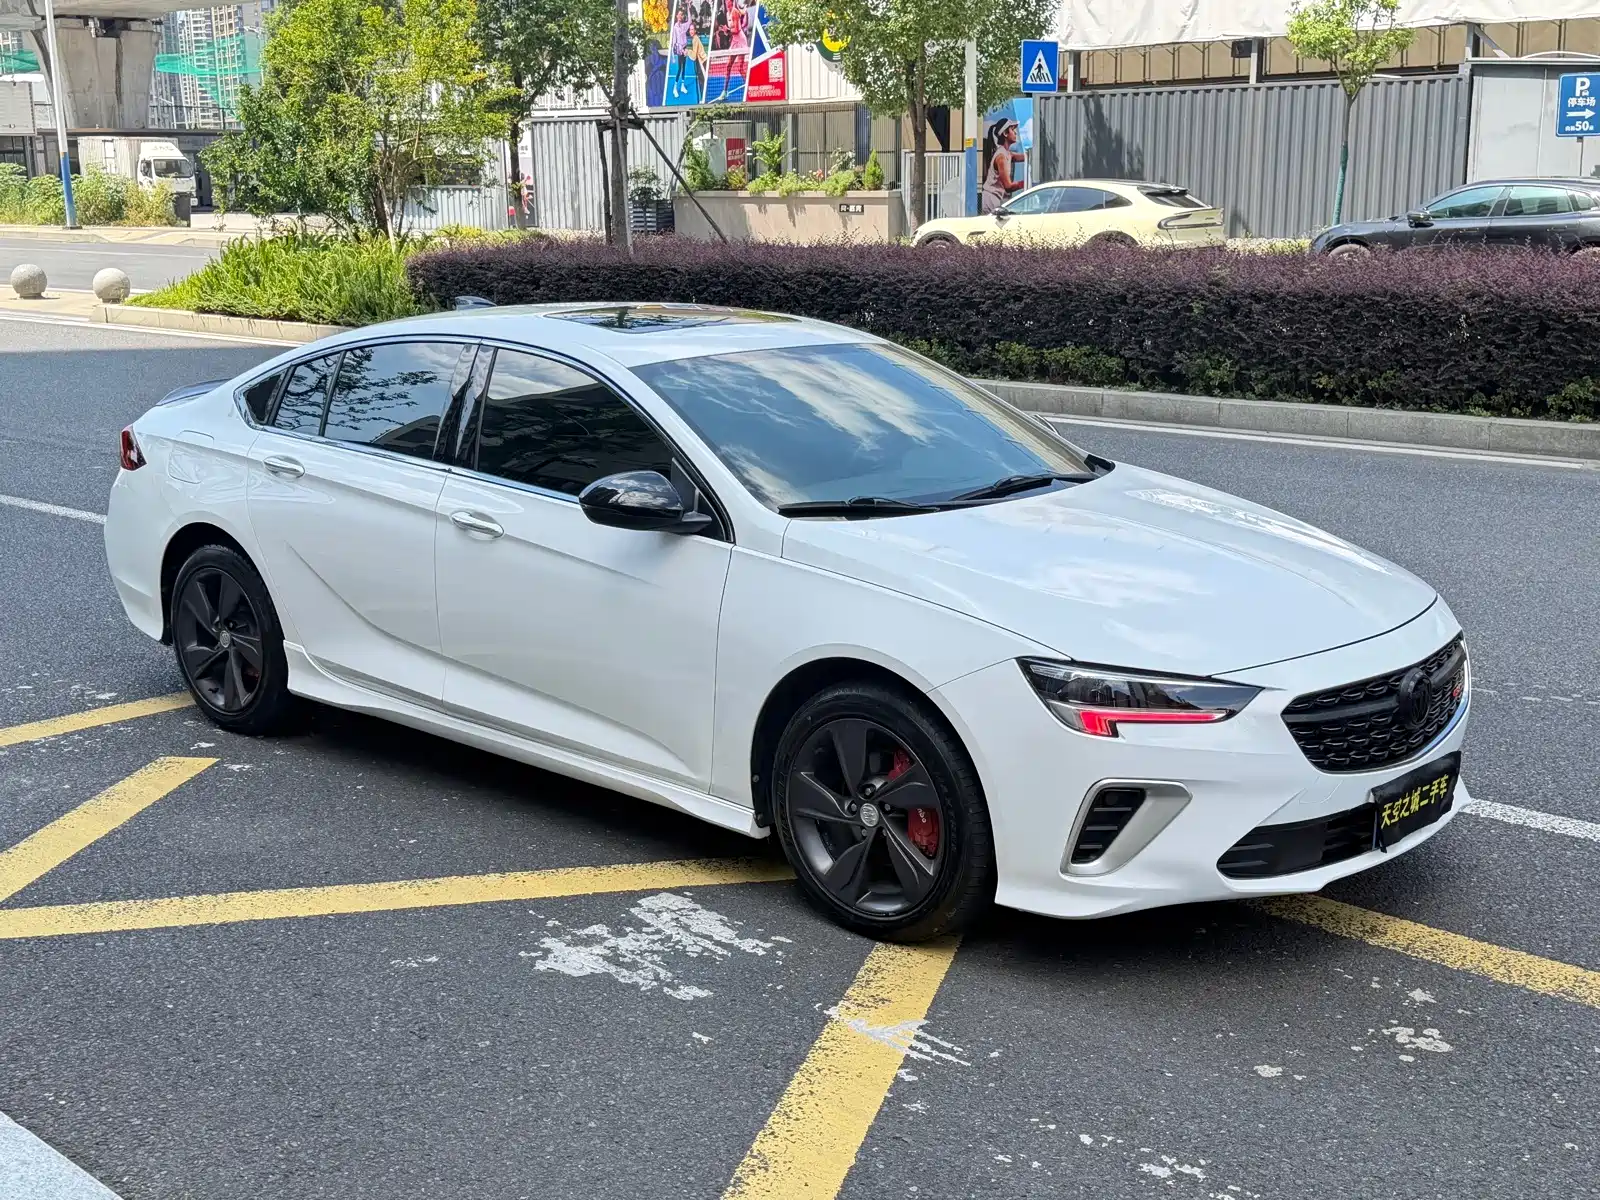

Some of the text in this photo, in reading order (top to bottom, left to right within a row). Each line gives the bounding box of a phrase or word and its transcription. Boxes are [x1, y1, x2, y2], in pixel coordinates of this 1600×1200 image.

[1575, 77, 1591, 97] P
[1567, 97, 1597, 107] 停车场
[1380, 774, 1449, 829] 天空之城二手车
